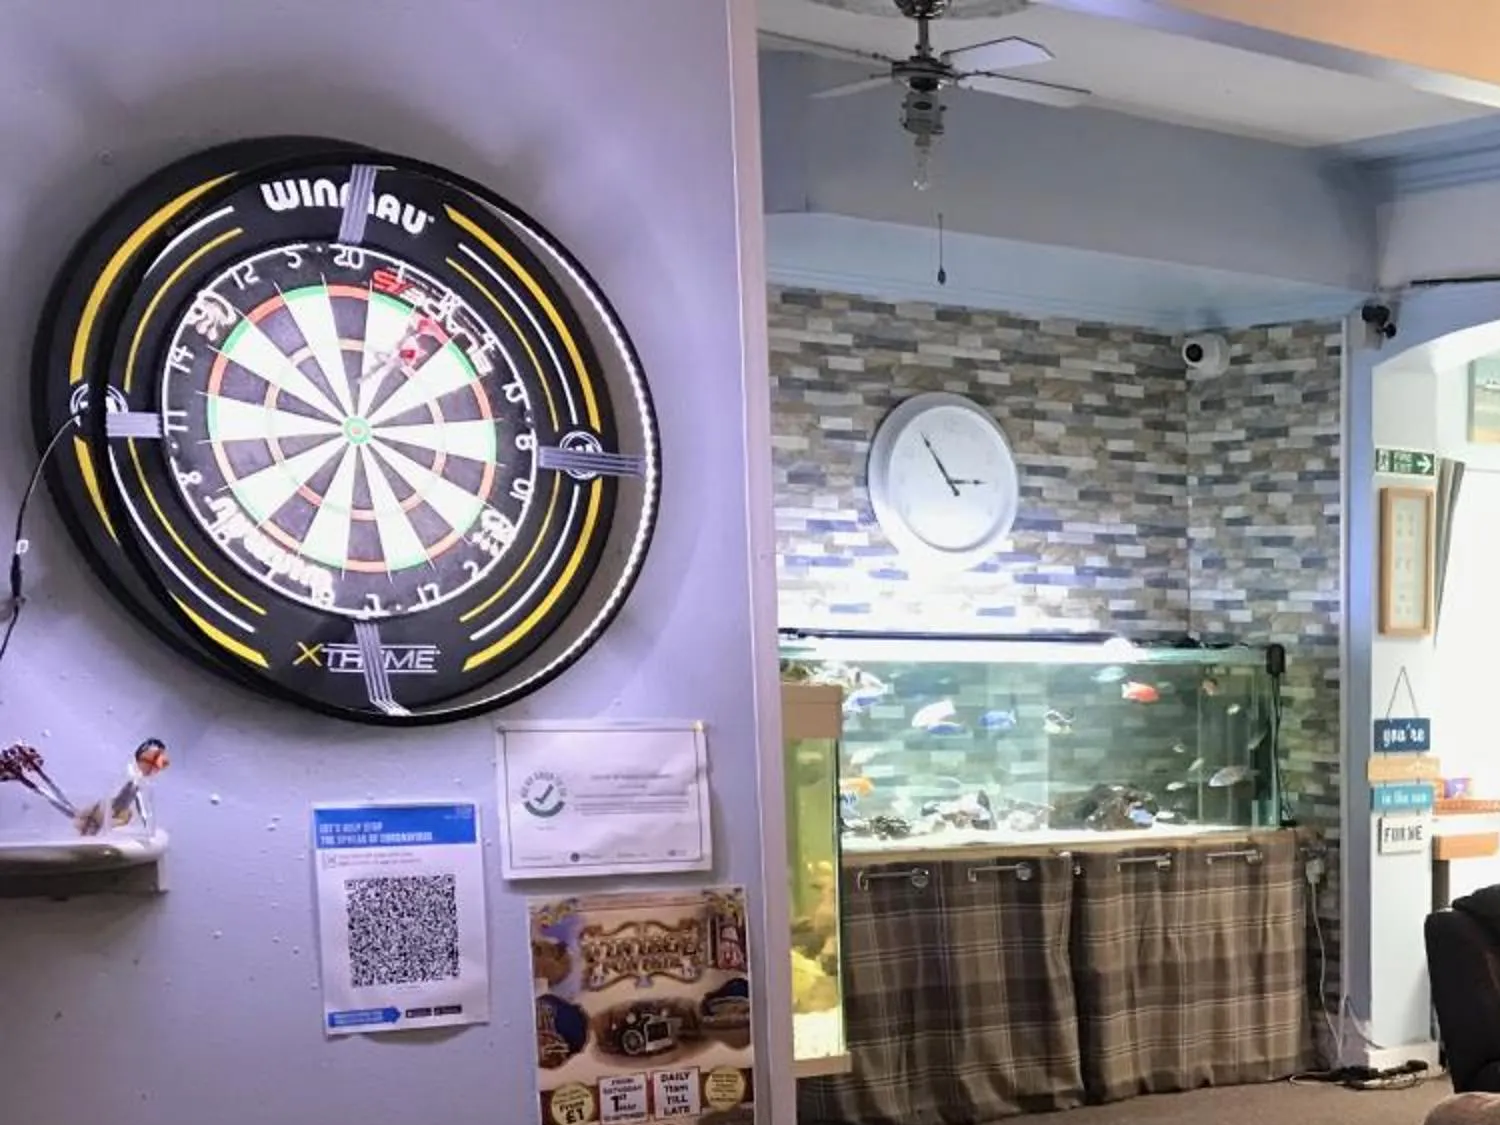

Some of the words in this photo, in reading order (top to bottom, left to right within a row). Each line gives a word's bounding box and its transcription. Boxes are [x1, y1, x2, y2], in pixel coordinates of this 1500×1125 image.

[333, 249, 365, 270] 20
[231, 262, 260, 290] 12
[170, 346, 195, 373] 14
[416, 582, 441, 605] 17
[292, 641, 441, 669] XTRME
[1383, 722, 1425, 748] you're
[660, 1071, 691, 1082] DAILY
[663, 1105, 691, 1116] LATE
[666, 1094, 689, 1105] TILL
[565, 1108, 585, 1125] £1
